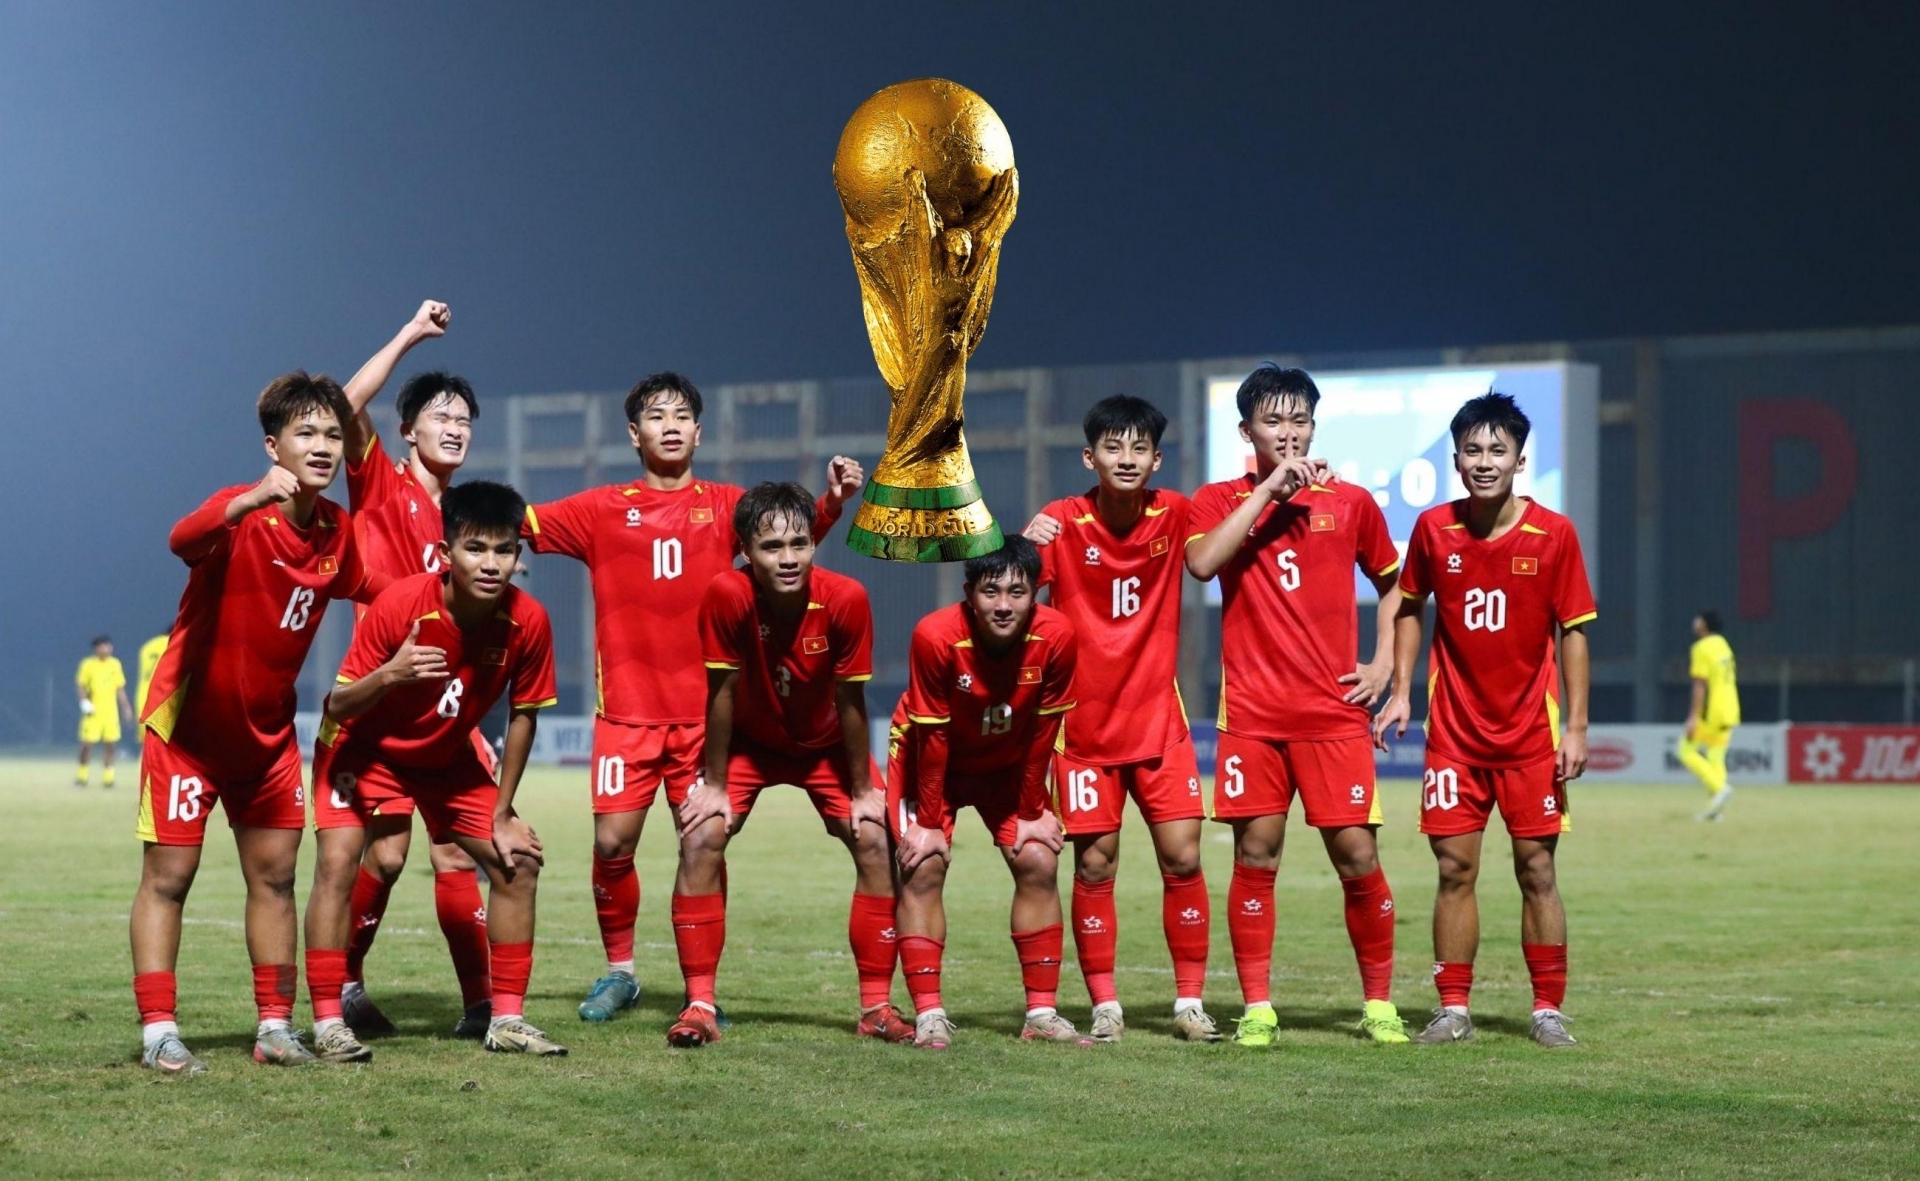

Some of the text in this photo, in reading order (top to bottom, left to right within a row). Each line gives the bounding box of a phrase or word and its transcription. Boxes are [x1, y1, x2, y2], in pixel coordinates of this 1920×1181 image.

[872, 518, 978, 538] WORLD CUP
[885, 508, 962, 522] FIFA
[1739, 397, 1858, 619] P
[653, 537, 683, 580] 10
[1277, 548, 1301, 593] 5
[279, 586, 315, 632] 13
[1112, 575, 1141, 619] 16
[1464, 587, 1507, 633] 20
[437, 677, 464, 718] 8
[981, 702, 1013, 736] 19
[596, 754, 625, 797] 10
[1224, 754, 1245, 799] 5
[1852, 735, 1920, 779] JOG
[167, 773, 203, 823] 13
[1068, 768, 1099, 814] 16
[1424, 767, 1459, 812] 20
